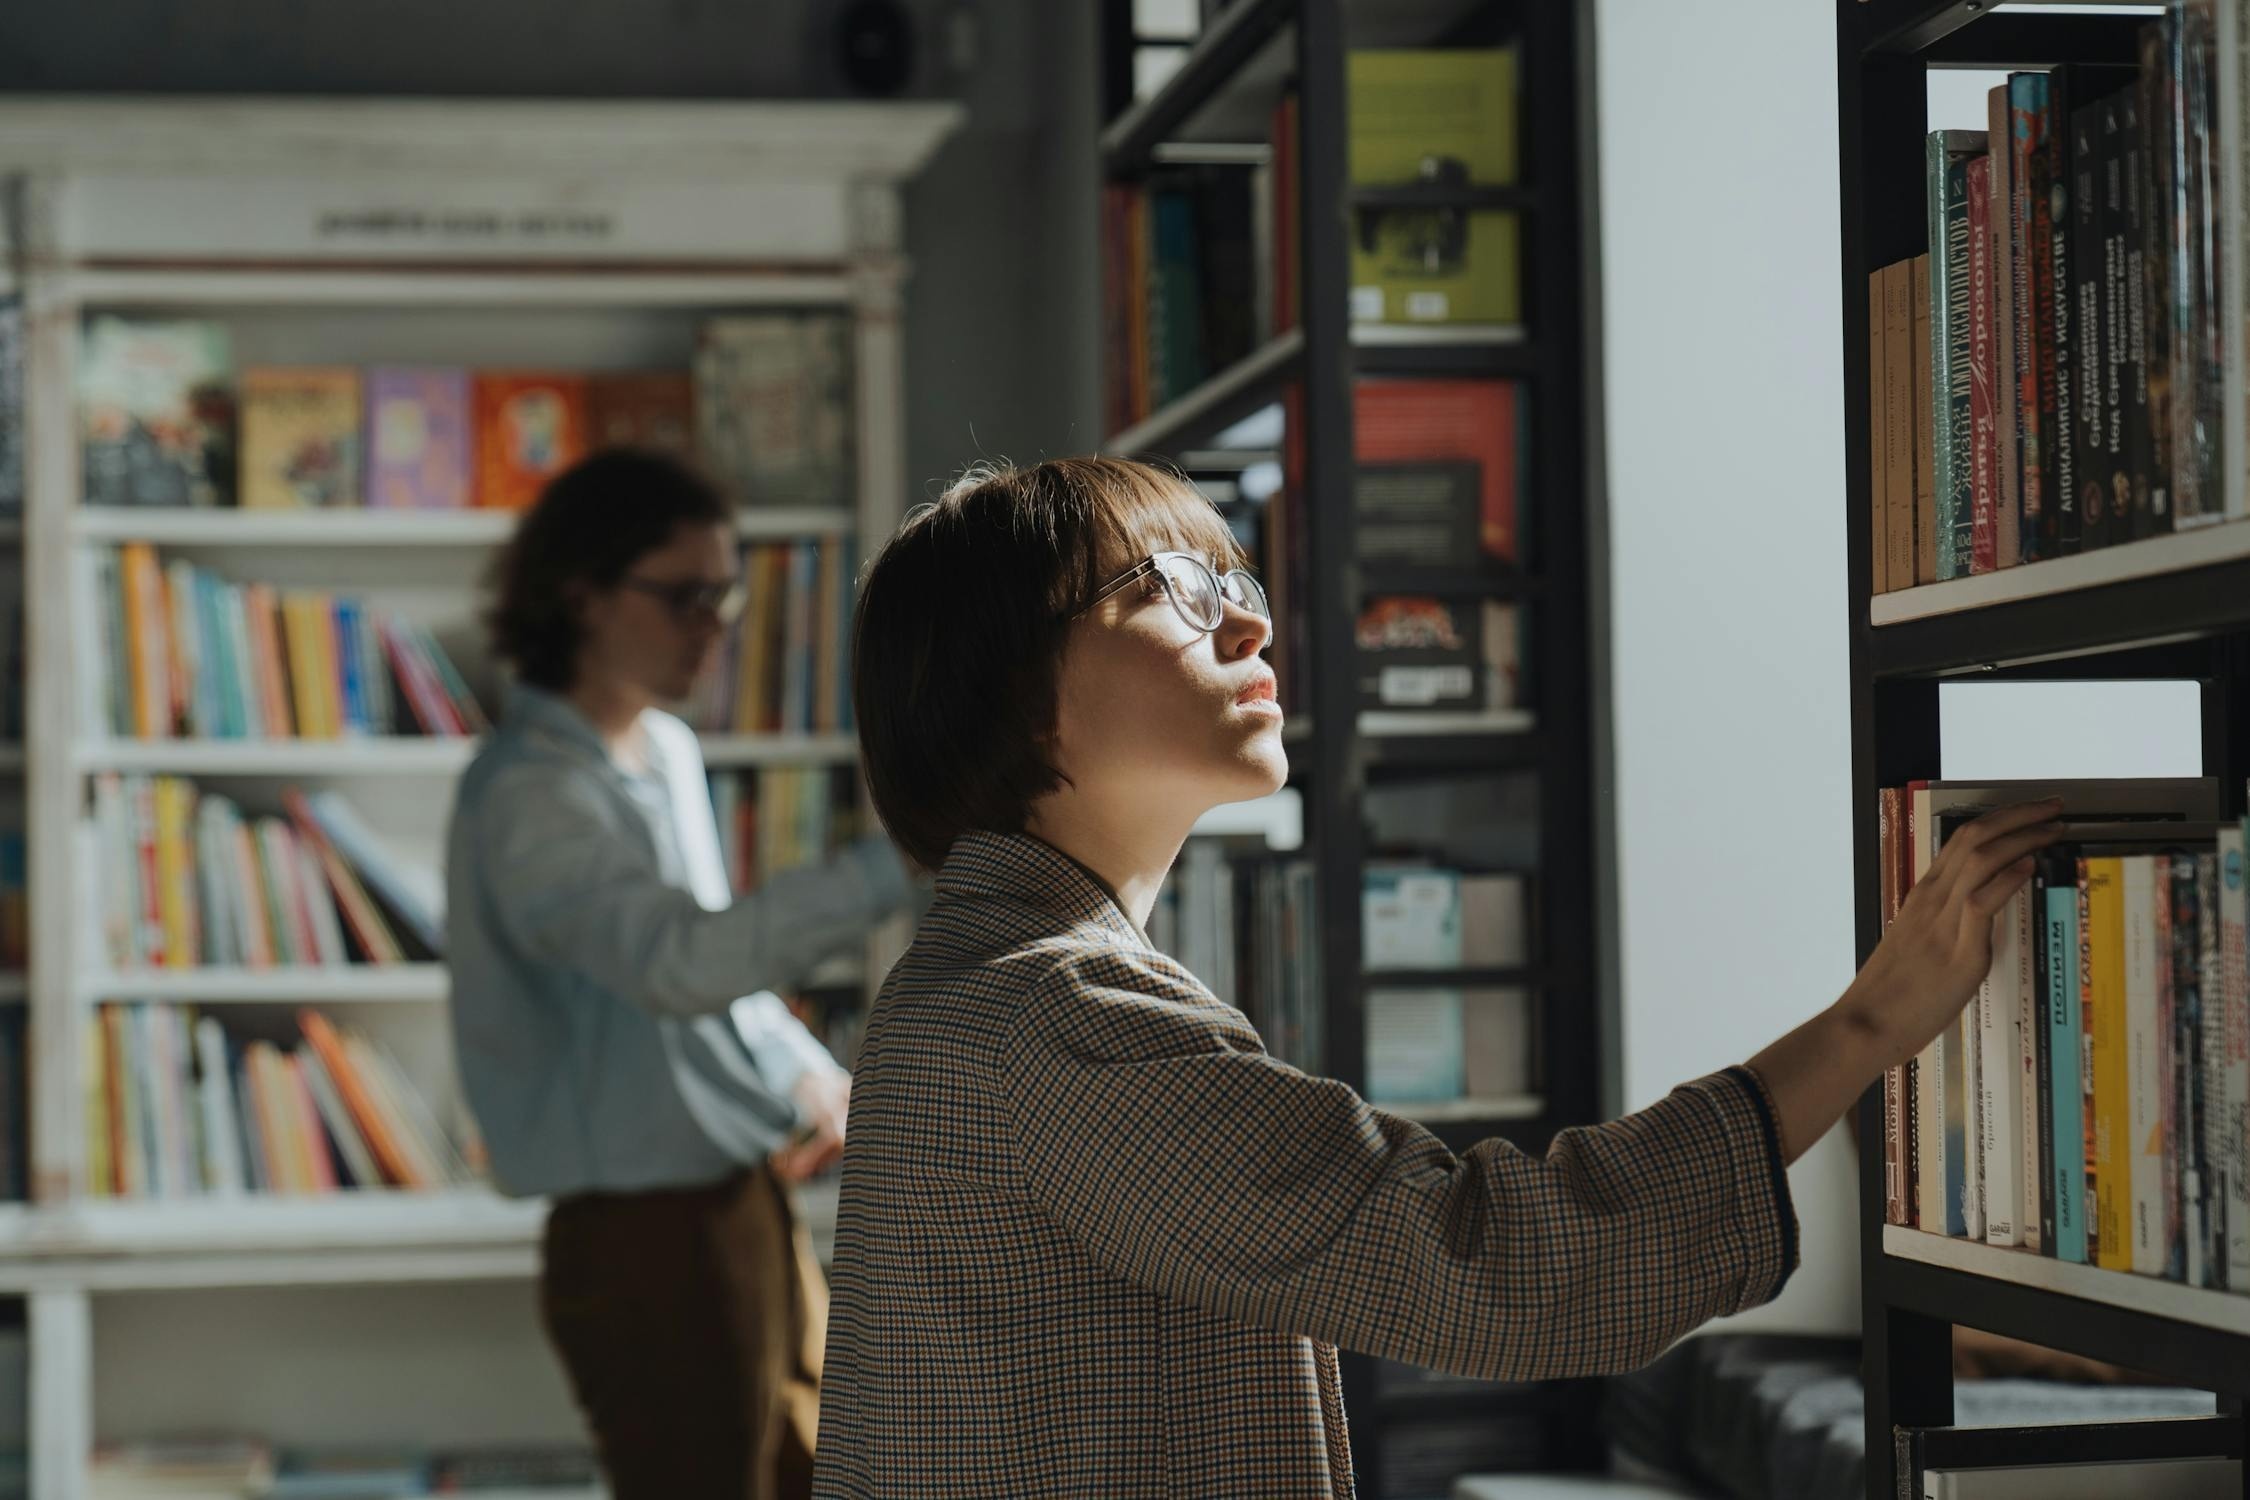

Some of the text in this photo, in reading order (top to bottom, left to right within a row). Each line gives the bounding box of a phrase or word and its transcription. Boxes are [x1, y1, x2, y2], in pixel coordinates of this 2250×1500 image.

[1949, 216, 1971, 398] ИМПРЕССИОНИСТОВ
[2053, 231, 2067, 343] ИСКУССТВЕ
[1970, 224, 1991, 527] Братья Морозовы
[2056, 367, 2072, 512] АПОКАЛИПСИС
